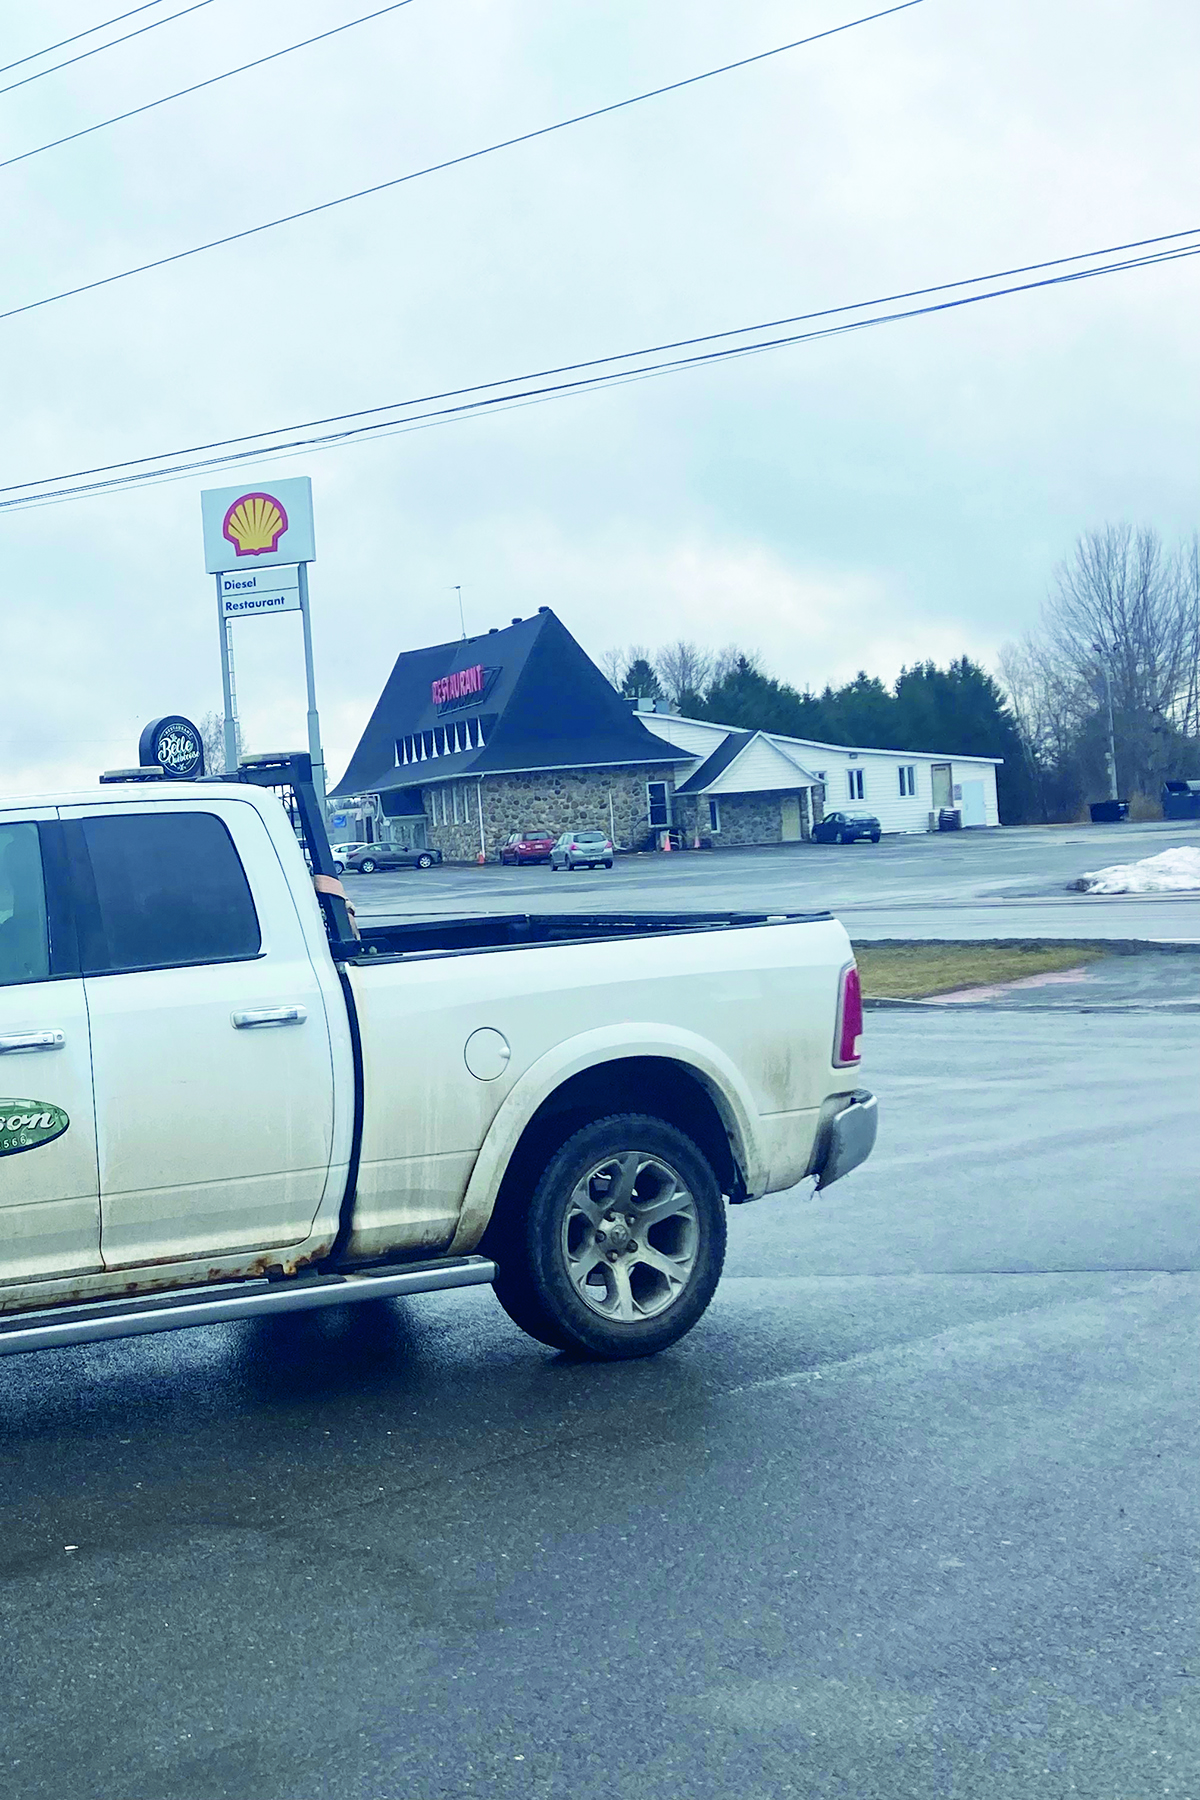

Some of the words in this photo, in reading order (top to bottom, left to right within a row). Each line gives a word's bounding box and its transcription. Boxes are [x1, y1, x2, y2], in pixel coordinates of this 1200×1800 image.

[224, 577, 257, 590] Diesel
[225, 596, 285, 611] Restaurant
[432, 664, 483, 704] RESTAURANT
[157, 736, 194, 763] Belle
